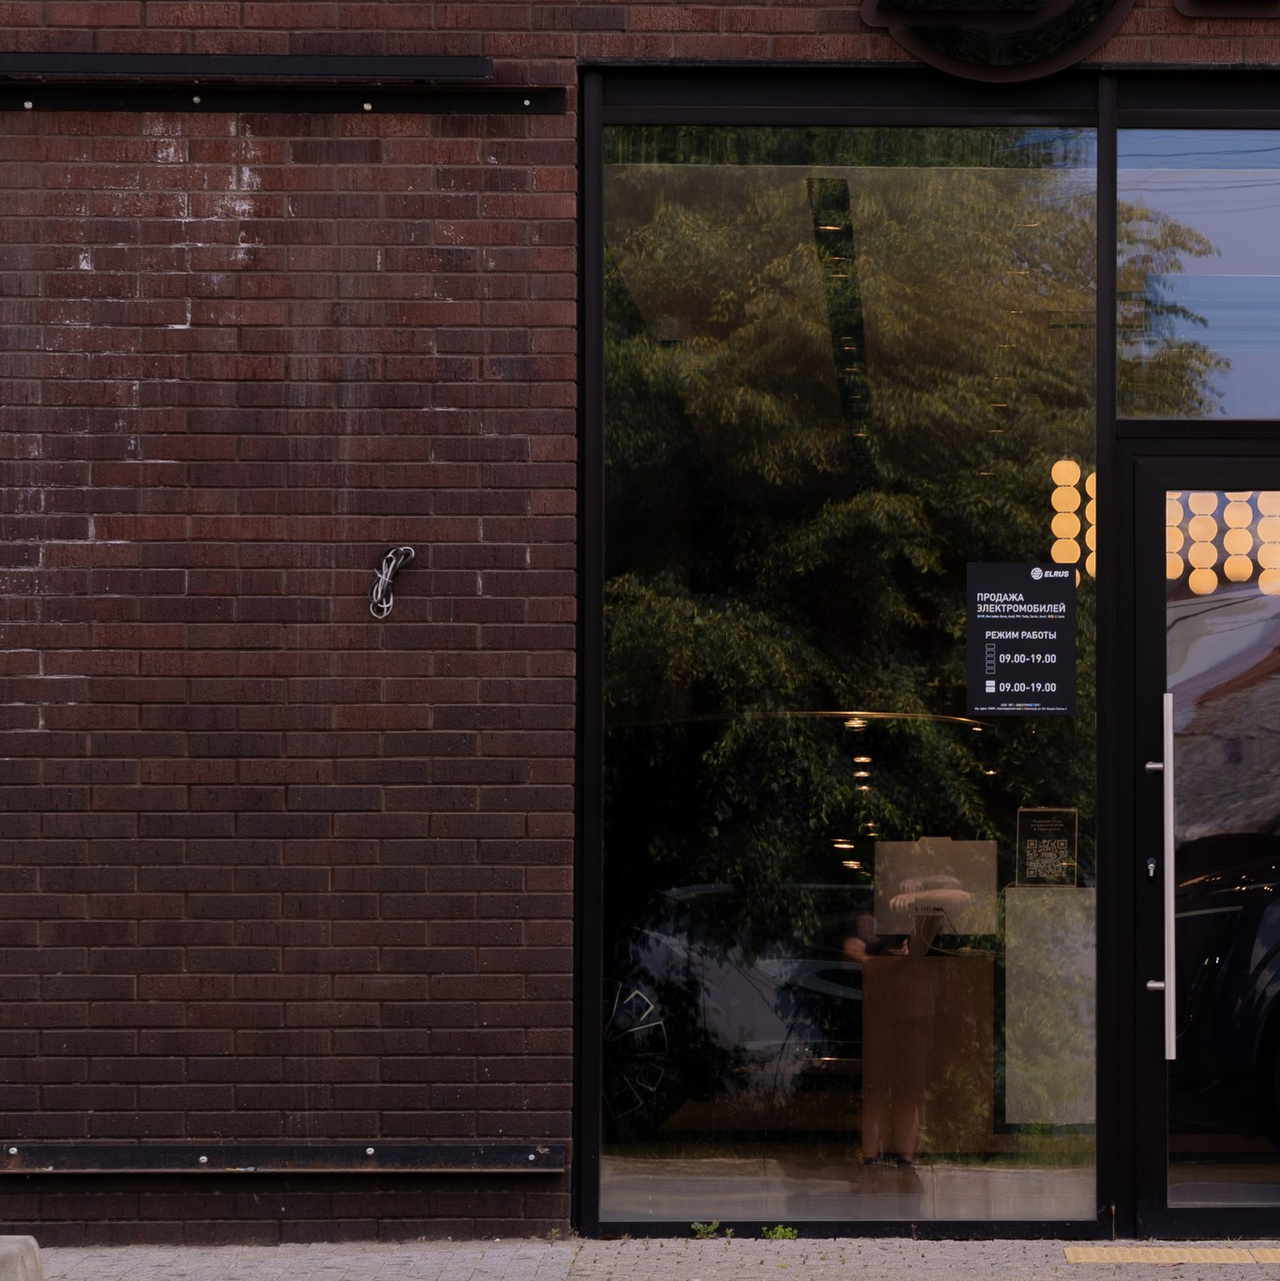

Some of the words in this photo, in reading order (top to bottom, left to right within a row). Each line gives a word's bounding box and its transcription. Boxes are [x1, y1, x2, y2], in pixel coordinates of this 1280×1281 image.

[1044, 570, 1070, 578] ELRUS
[976, 592, 1025, 603] ПРОДАЖА
[976, 602, 1066, 613] ЭЛЕКТРОМОБИЛЕЙ
[985, 630, 1019, 640] РЕЖИМ
[1021, 630, 1057, 640] РАБОТЫ
[999, 653, 1057, 664] 09.00-19.00
[999, 682, 1057, 693] 09.00-19.00
